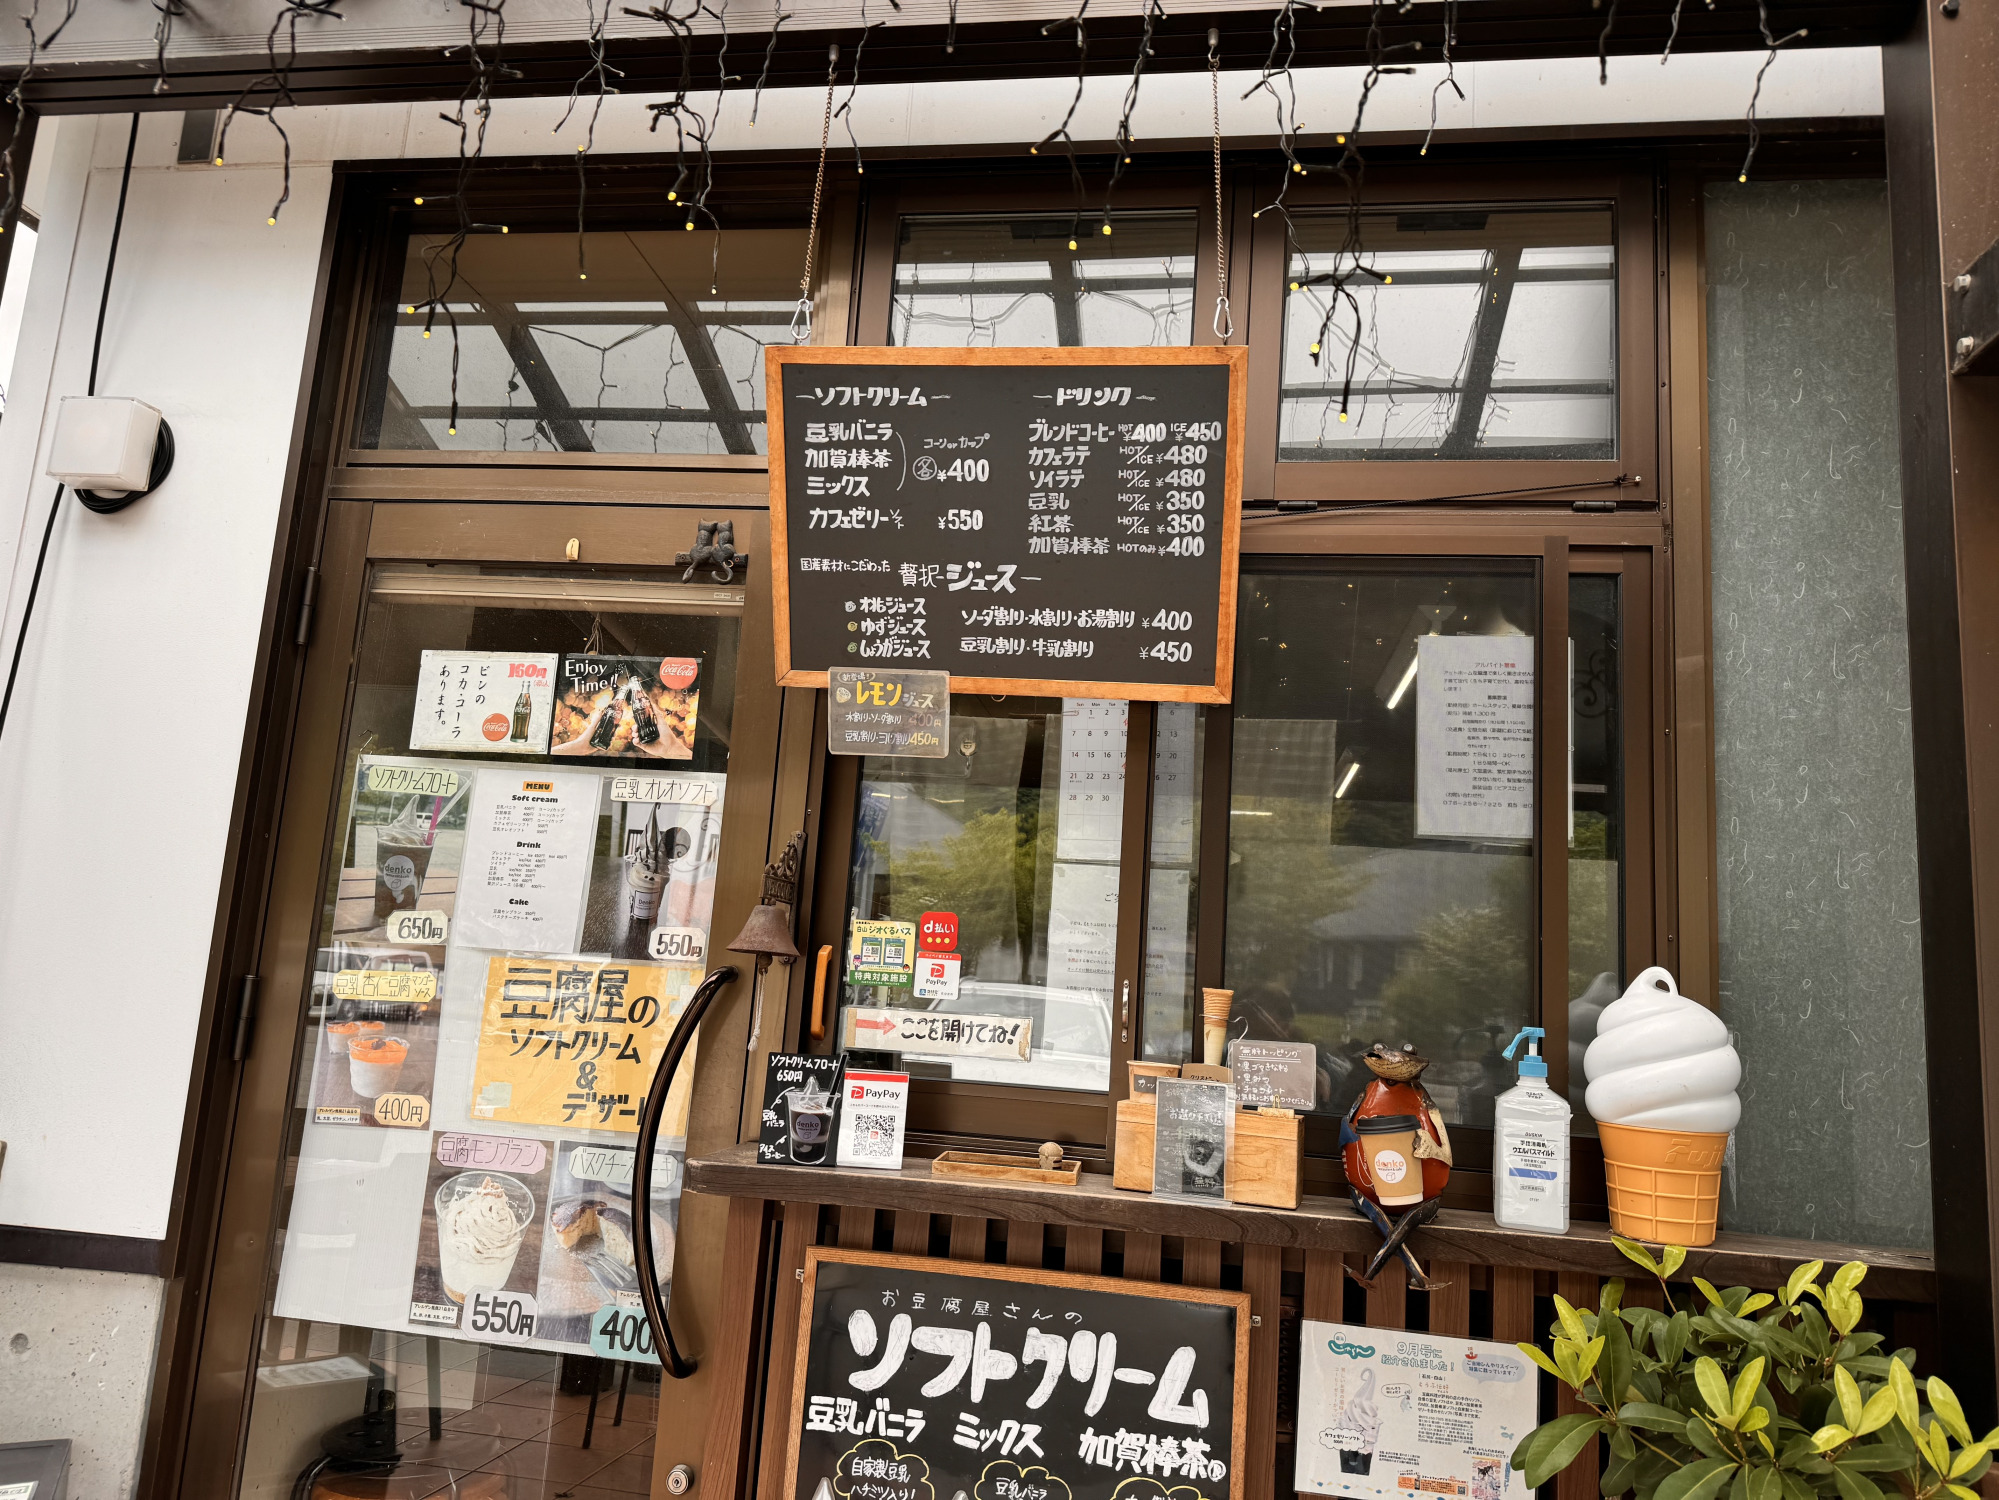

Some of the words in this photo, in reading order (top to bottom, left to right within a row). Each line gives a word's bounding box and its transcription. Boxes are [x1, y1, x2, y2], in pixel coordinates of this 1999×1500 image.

[814, 386, 928, 407] ソフトクリーム
[1056, 386, 1132, 406] ドリンク
[804, 419, 893, 443] 豆乳バニラ
[1028, 418, 1115, 442] ブレンドコーヒー
[1170, 422, 1188, 432] ICE
[804, 448, 893, 469] 加賀棒茶
[1028, 445, 1091, 466] カフェラテ
[1155, 444, 1208, 465] ¥480
[936, 458, 990, 482] ¥400
[1029, 468, 1085, 488] ソイラテ
[1155, 468, 1206, 488] ¥480
[806, 475, 871, 497] ミックス
[1028, 492, 1070, 511] 豆乳
[1155, 490, 1205, 511] ¥350
[938, 509, 984, 531] ¥550
[1028, 514, 1075, 533] 紅茶
[1156, 513, 1205, 534] ¥350
[1028, 535, 1110, 555] 加賀棒茶
[1157, 535, 1205, 557] ¥400
[800, 557, 891, 573] 国産素材にこだわった
[859, 597, 927, 616] 桃ジュース
[860, 616, 927, 636] ゆずジュース
[1141, 608, 1193, 631] ¥400
[859, 636, 931, 659] しょうがジュース
[1139, 641, 1193, 663] ¥450
[507, 663, 548, 679] 160円
[565, 659, 608, 677] Enjoy
[434, 665, 451, 726] あります。
[475, 665, 491, 705] ビンの
[856, 681, 902, 707] レモン
[902, 692, 934, 709] ジュース
[909, 732, 939, 746] 450円
[1169, 752, 1177, 760] 20
[375, 768, 457, 795] ソフトクリームフロート
[525, 782, 551, 791] MENU
[1069, 772, 1077, 780] 21
[511, 794, 530, 802] Soft
[531, 796, 559, 804] cream
[1085, 794, 1094, 802] 29
[1101, 794, 1110, 802] 30
[516, 841, 542, 849] Drink
[384, 864, 412, 875] denko
[508, 898, 530, 906] Cake
[397, 916, 444, 940] 650円
[923, 919, 955, 934] d払い
[656, 933, 703, 958] 550円
[854, 972, 908, 984] 特典対象施設
[925, 978, 948, 987] PayPay
[414, 987, 432, 998] ソース
[500, 963, 661, 1029] 豆腐屋の
[900, 1017, 1021, 1045] ここを開けてね!
[509, 1028, 642, 1065] ソフトクリーム
[770, 1054, 840, 1072] ソフトクリームフロート
[575, 1060, 598, 1092] &
[776, 1070, 804, 1083] 650円
[865, 1088, 901, 1101] PayPay
[378, 1097, 424, 1123] 400円
[766, 1119, 785, 1127] バニラ
[796, 1120, 820, 1128] denko
[440, 1135, 540, 1167] 豆腐モンブラン
[471, 1293, 535, 1338] 550円
[881, 1289, 1083, 1325] お豆腐屋さんの
[599, 1309, 658, 1355] 400
[1396, 1341, 1443, 1359] 9月号に
[848, 1308, 1210, 1429] ソフトクリーム
[805, 1395, 927, 1444] 豆乳バニラ
[952, 1411, 1046, 1459] ミックス
[851, 1456, 912, 1484] 自家製豆乳
